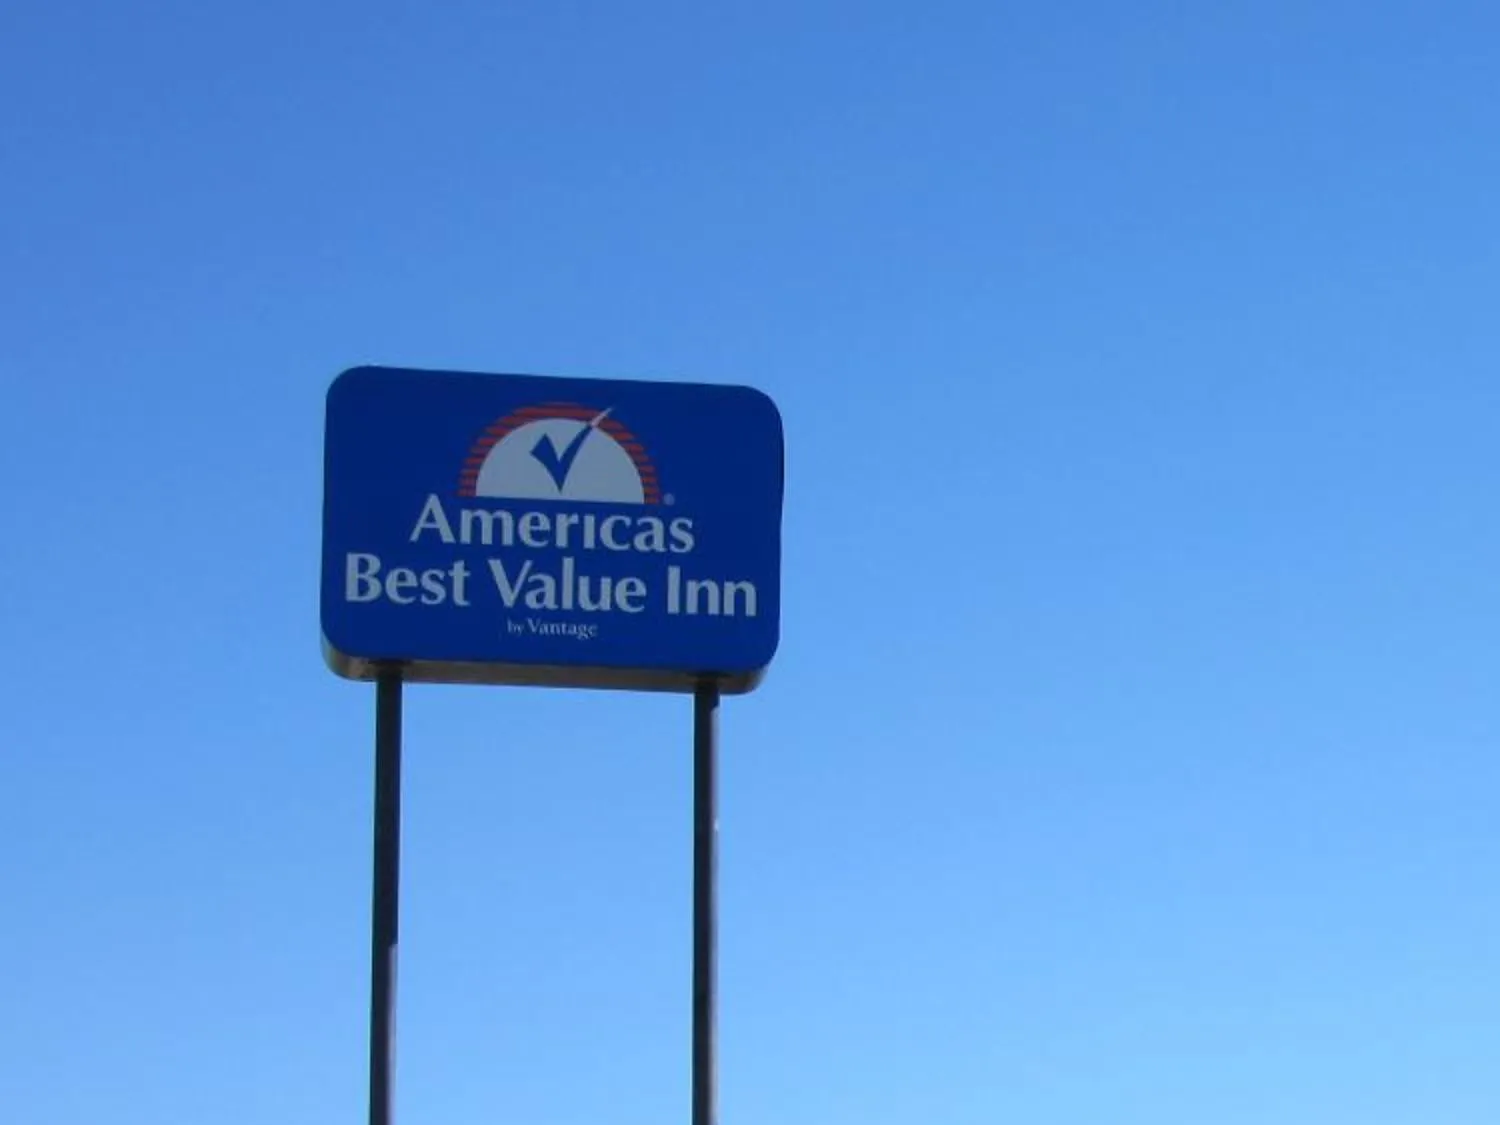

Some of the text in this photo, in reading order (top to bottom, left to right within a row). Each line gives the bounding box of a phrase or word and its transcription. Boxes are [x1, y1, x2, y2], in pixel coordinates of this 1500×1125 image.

[410, 493, 695, 553] Americas
[345, 553, 757, 617] Best Value Inn
[507, 616, 599, 640] by Vantage
